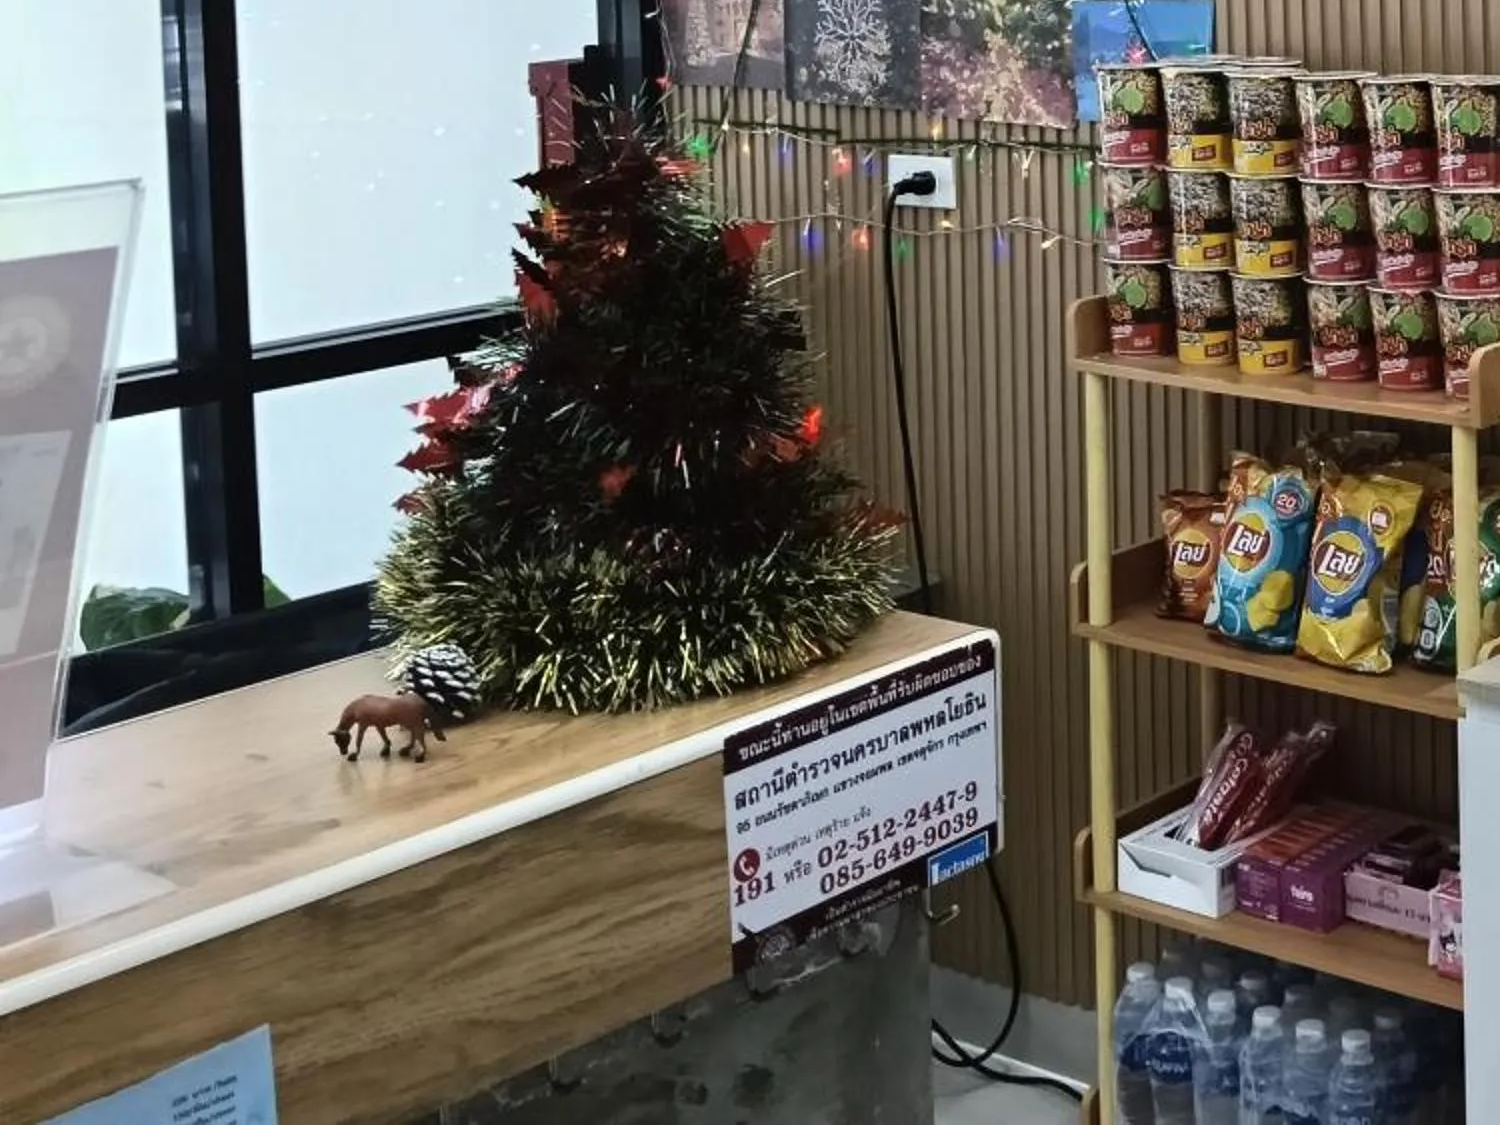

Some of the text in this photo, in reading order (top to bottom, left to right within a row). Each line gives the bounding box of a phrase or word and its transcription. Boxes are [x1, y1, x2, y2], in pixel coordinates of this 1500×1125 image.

[733, 692, 987, 810] สถานีตำรวจนครบาลพหลโยธิน
[734, 872, 776, 907] 191
[817, 781, 978, 868] 02-512-2447-9
[820, 807, 979, 894] 085-649-9039
